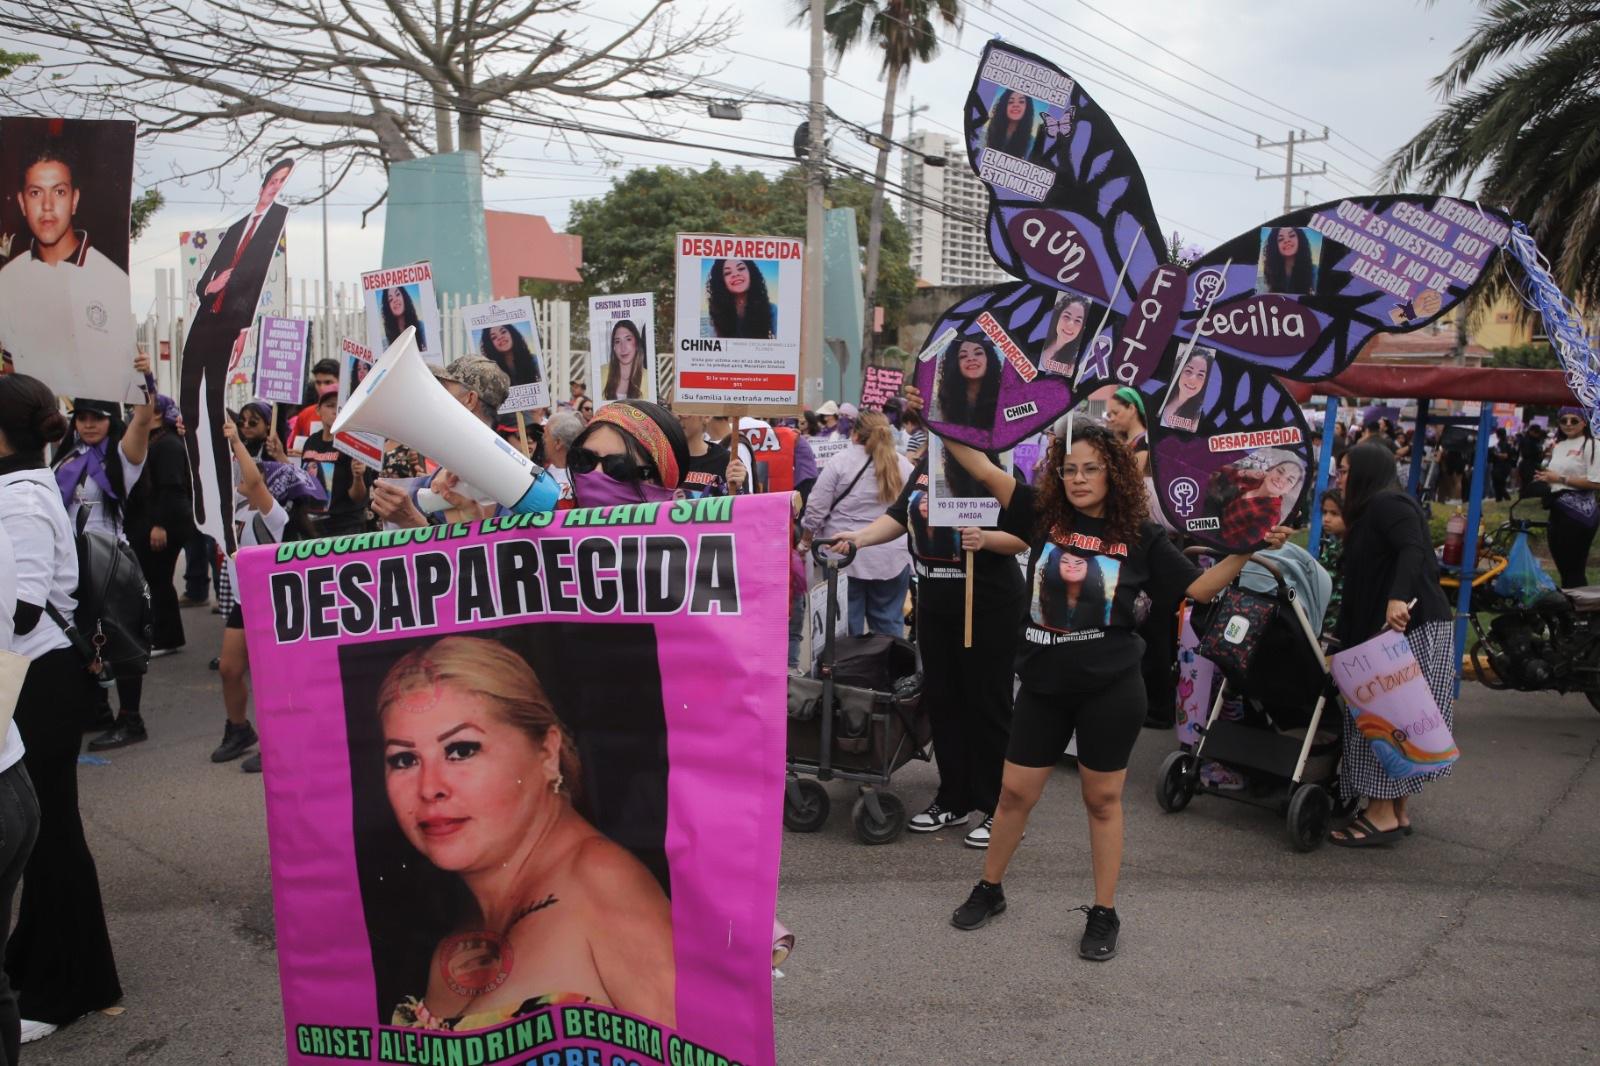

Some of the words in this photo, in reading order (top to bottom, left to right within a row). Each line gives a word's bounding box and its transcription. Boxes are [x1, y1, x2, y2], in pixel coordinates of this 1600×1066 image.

[990, 51, 1003, 66] SI
[1003, 54, 1025, 73] HAY
[1024, 61, 1051, 81] ALGO
[1051, 71, 1072, 93] QUE
[983, 67, 1011, 88] DEBO
[1011, 76, 1068, 108] RECONOCER
[984, 149, 998, 166] EL
[997, 153, 1028, 176] AMOR
[1030, 165, 1055, 188] POR
[980, 167, 1006, 187] ESTA
[1006, 176, 1047, 200] MUJER!
[1432, 196, 1509, 246] HERMANA
[682, 238, 801, 260] DESAPARECIDA
[1336, 199, 1368, 227] QUE
[1364, 214, 1388, 239] ES
[1384, 223, 1453, 270] NUESTRO
[1448, 263, 1480, 286] DÍA
[1452, 232, 1490, 261] HOY
[363, 265, 431, 290] DESAPARECIDA
[1391, 253, 1407, 271] Y
[1403, 261, 1429, 283] NO
[1427, 270, 1453, 294] DE
[595, 300, 621, 310] CRISTINA
[632, 298, 646, 307] ERES
[611, 310, 631, 319] MUJER
[343, 339, 374, 363] DESAPAR
[681, 339, 722, 352] CHINA
[977, 313, 1036, 382] DESAPARECIDA
[696, 393, 722, 401] familia
[1006, 403, 1035, 419] CHINA
[747, 427, 781, 451] CA
[819, 443, 848, 452] DEUDOR
[1210, 429, 1300, 450] DESAPARECIDA
[671, 496, 735, 523] SM
[937, 501, 947, 509] YO
[956, 501, 968, 509] SOY
[979, 501, 1001, 509] MEJO
[958, 512, 983, 520] AMIGA
[1188, 519, 1218, 530] CHINA
[271, 533, 741, 644] DESAPARECIDA
[1025, 627, 1051, 645] CHINA
[297, 1025, 371, 1059] GRISET
[380, 1013, 555, 1066] ALEJANDRINA
[565, 1010, 663, 1059] BECERRA
[669, 1034, 745, 1066] GAM
